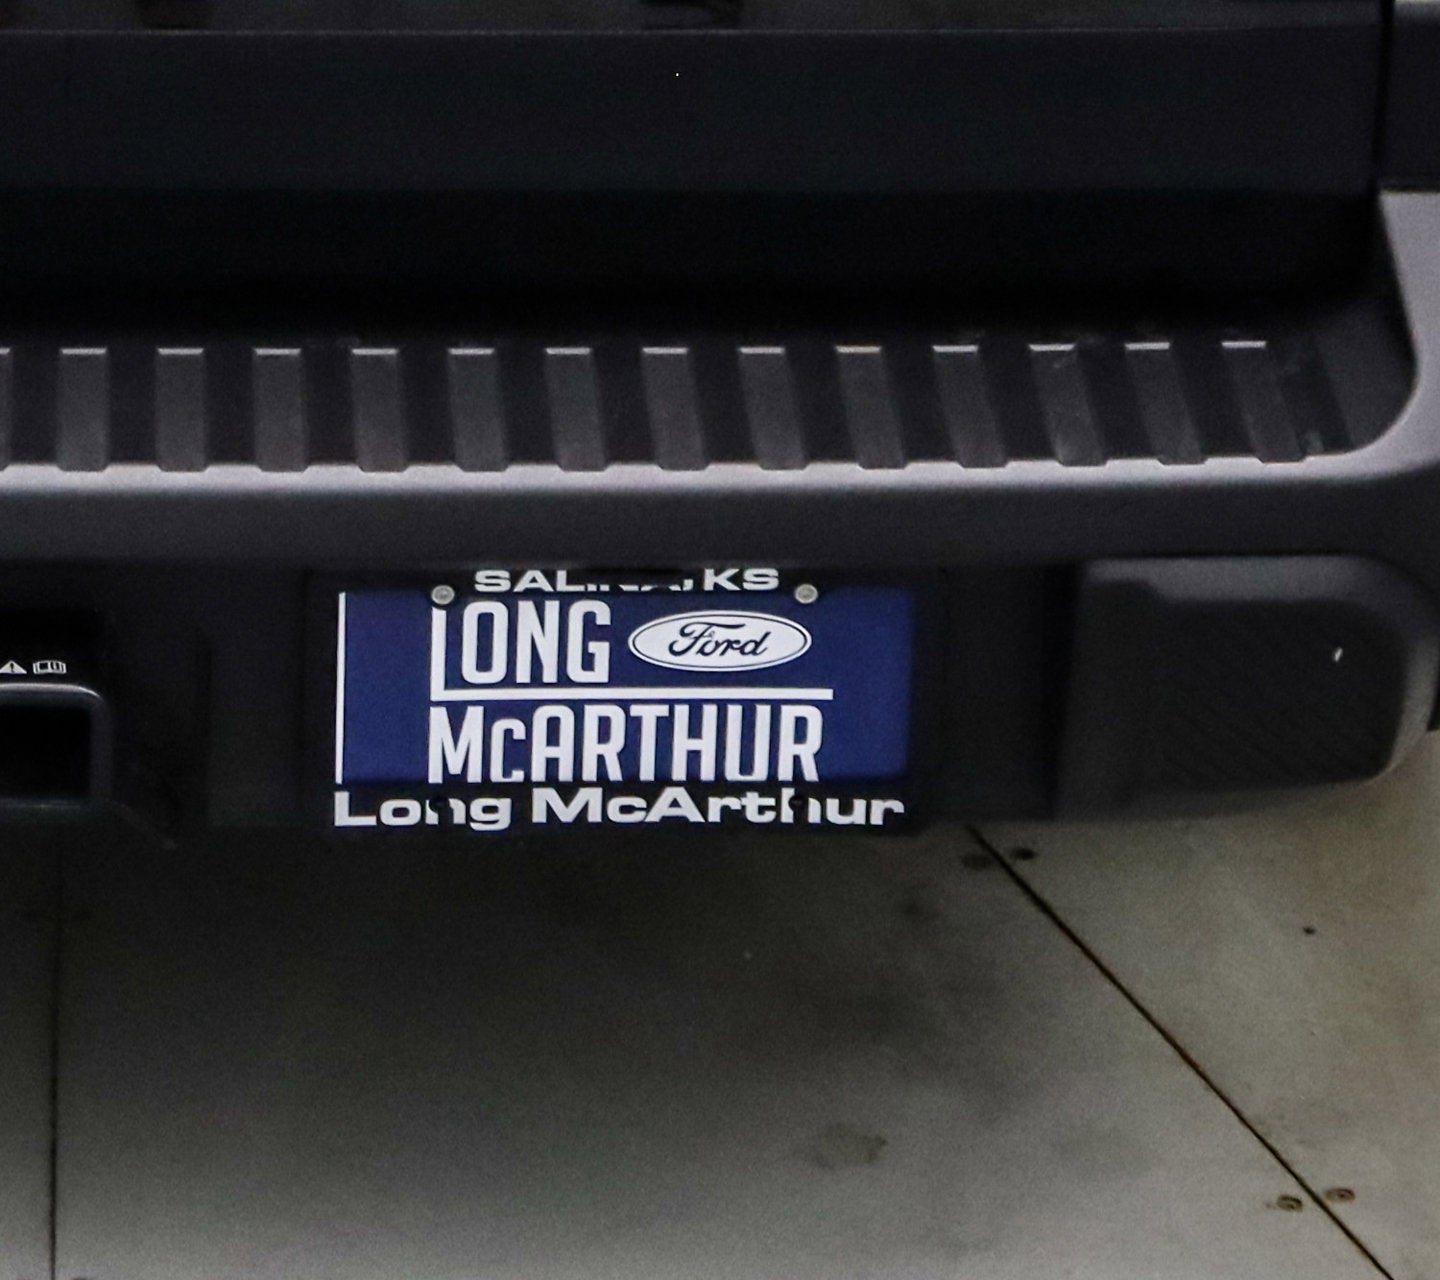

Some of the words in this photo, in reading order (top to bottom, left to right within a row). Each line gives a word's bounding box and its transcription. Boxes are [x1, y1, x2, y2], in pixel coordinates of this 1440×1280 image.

[430, 600, 612, 701] LONG
[667, 621, 772, 659] Ford
[428, 704, 824, 784] McARTHUR
[334, 790, 512, 831] Long
[532, 786, 905, 826] McArthur
